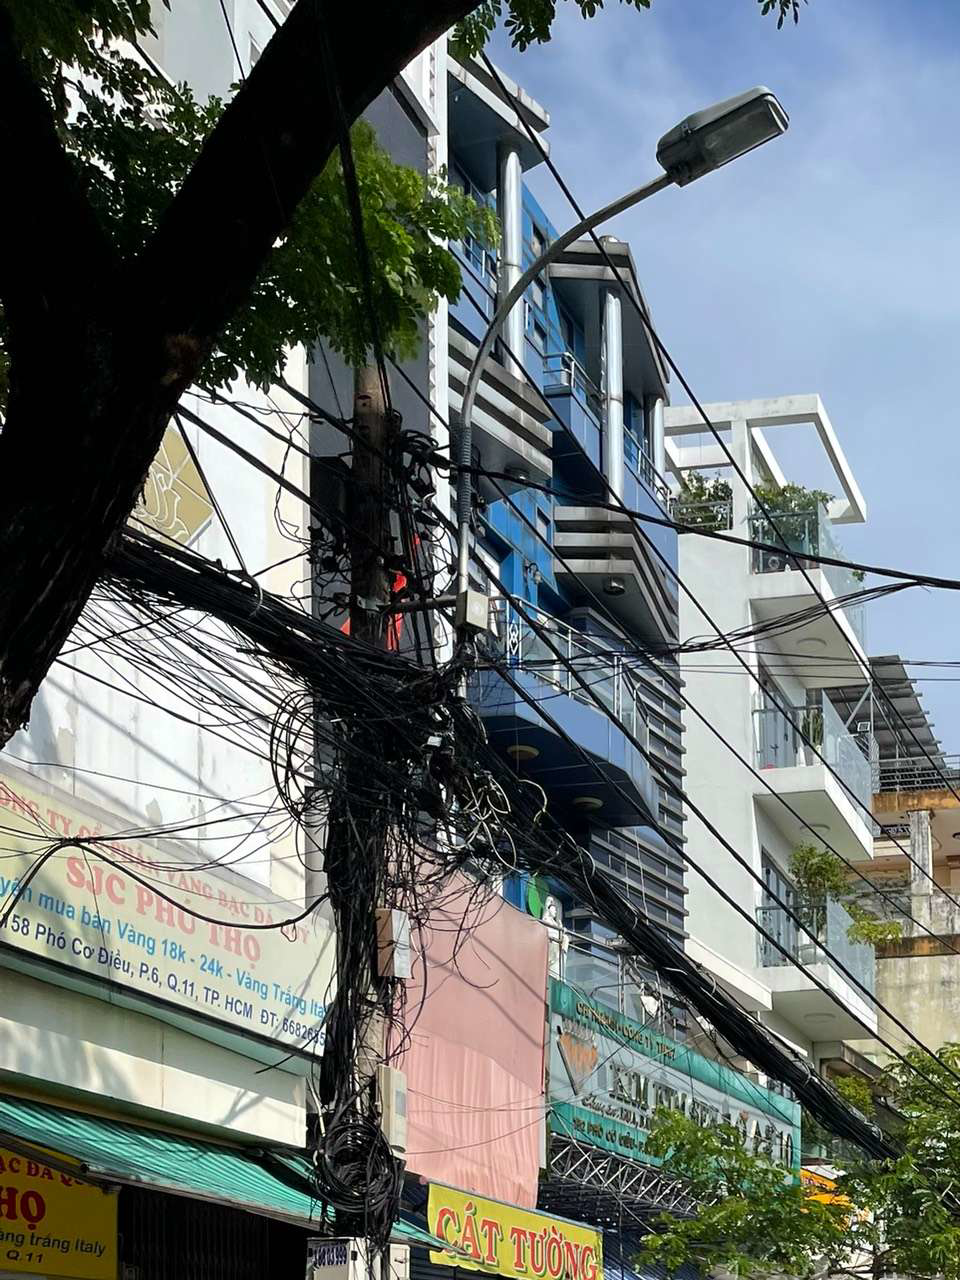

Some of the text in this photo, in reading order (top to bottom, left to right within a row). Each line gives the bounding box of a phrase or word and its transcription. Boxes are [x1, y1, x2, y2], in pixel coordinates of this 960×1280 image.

[66, 856, 126, 906] SJC
[38, 893, 75, 920] mua
[117, 919, 156, 955] Vàng
[161, 938, 186, 964] 18k
[200, 954, 224, 979] 24k
[236, 968, 268, 1000] Vàng
[225, 995, 253, 1019] HCM
[75, 1237, 106, 1258] Italy
[436, 1201, 503, 1264] CÁT
